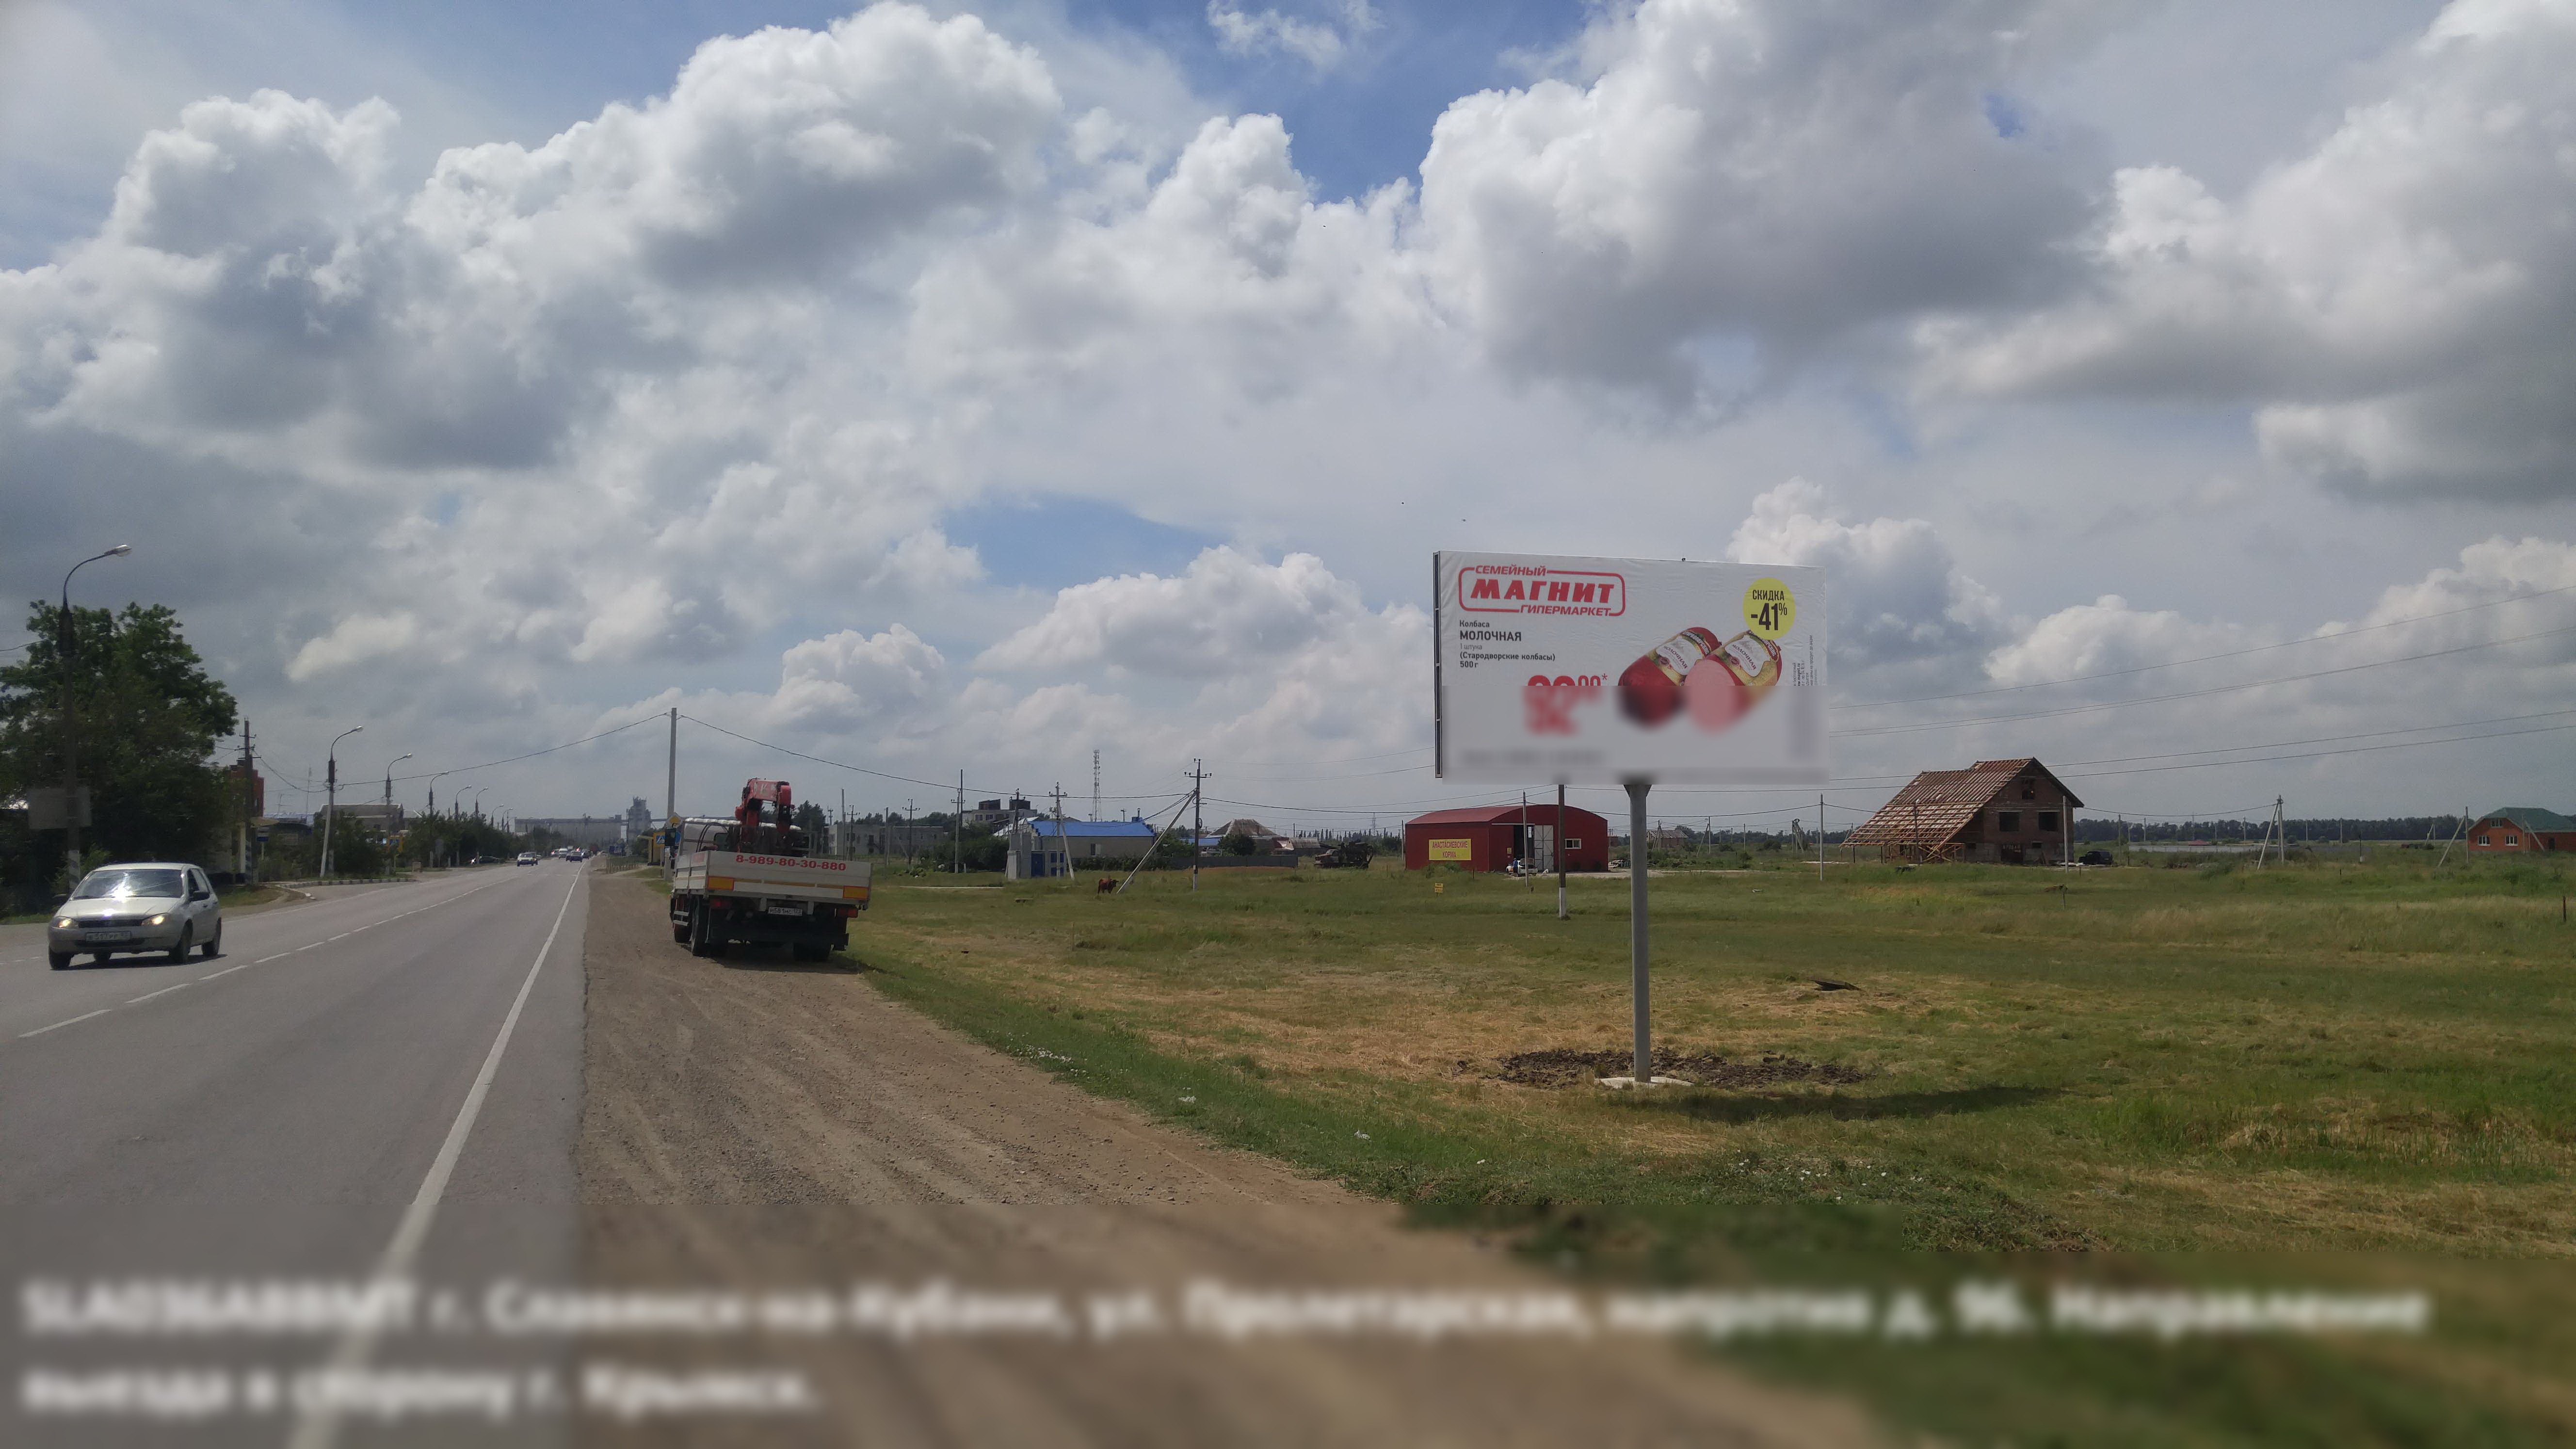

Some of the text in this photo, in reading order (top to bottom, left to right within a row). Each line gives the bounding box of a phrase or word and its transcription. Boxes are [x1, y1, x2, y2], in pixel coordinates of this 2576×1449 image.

[1475, 564, 1546, 577] СЕМЕЙНЫЙ
[1470, 579, 1614, 604] МАГНИТ
[1753, 589, 1785, 601] СКИДКА
[1520, 604, 1611, 616] ГИПЕРМАРКЕТ
[1751, 602, 1787, 630] -41%
[1460, 630, 1522, 642] МОЛОЧНАЯ
[1460, 651, 1556, 662] (Стародворские колбасы)
[736, 855, 847, 871] 8-989-80-30-880
